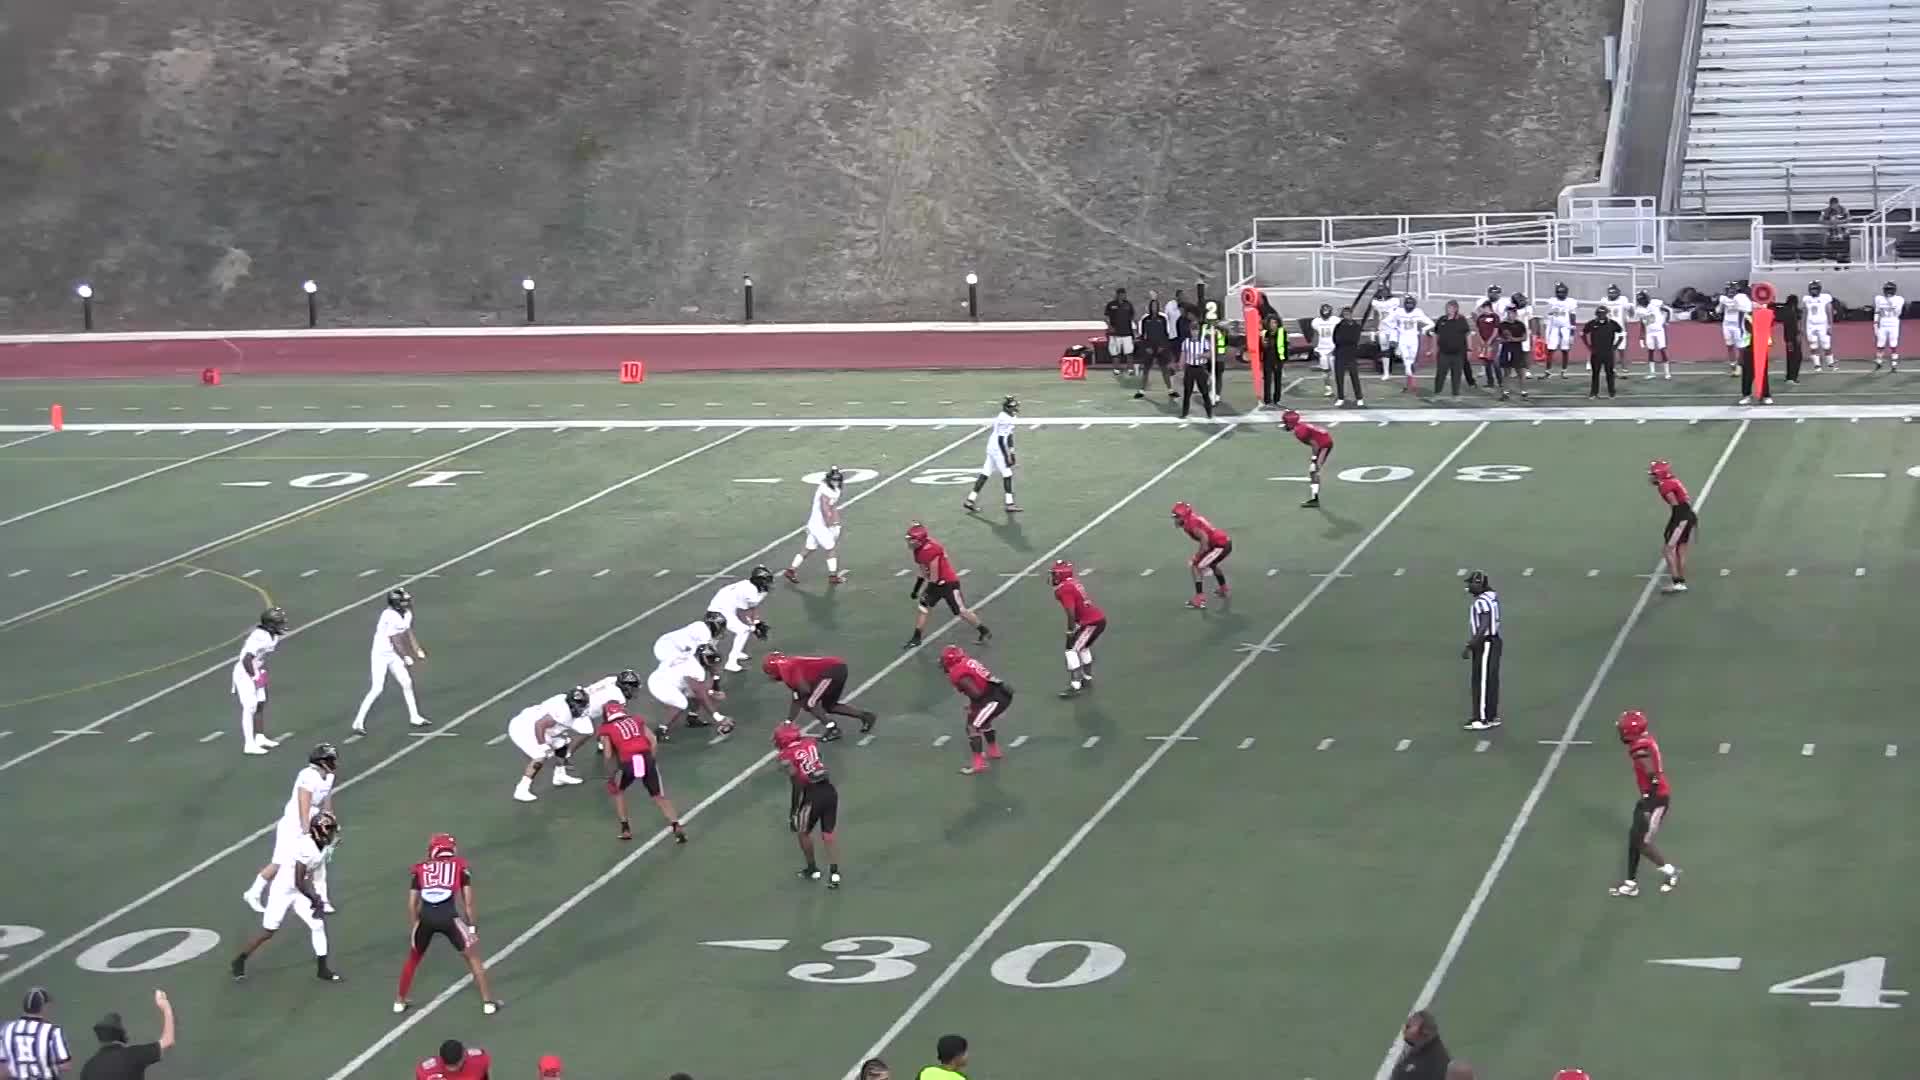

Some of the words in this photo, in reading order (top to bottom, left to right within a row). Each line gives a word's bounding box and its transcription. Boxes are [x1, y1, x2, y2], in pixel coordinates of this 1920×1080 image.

[1205, 301, 1218, 320] 2
[623, 363, 640, 378] 10
[1063, 359, 1081, 377] 20
[423, 861, 456, 887] 20
[787, 935, 1127, 988] 30
